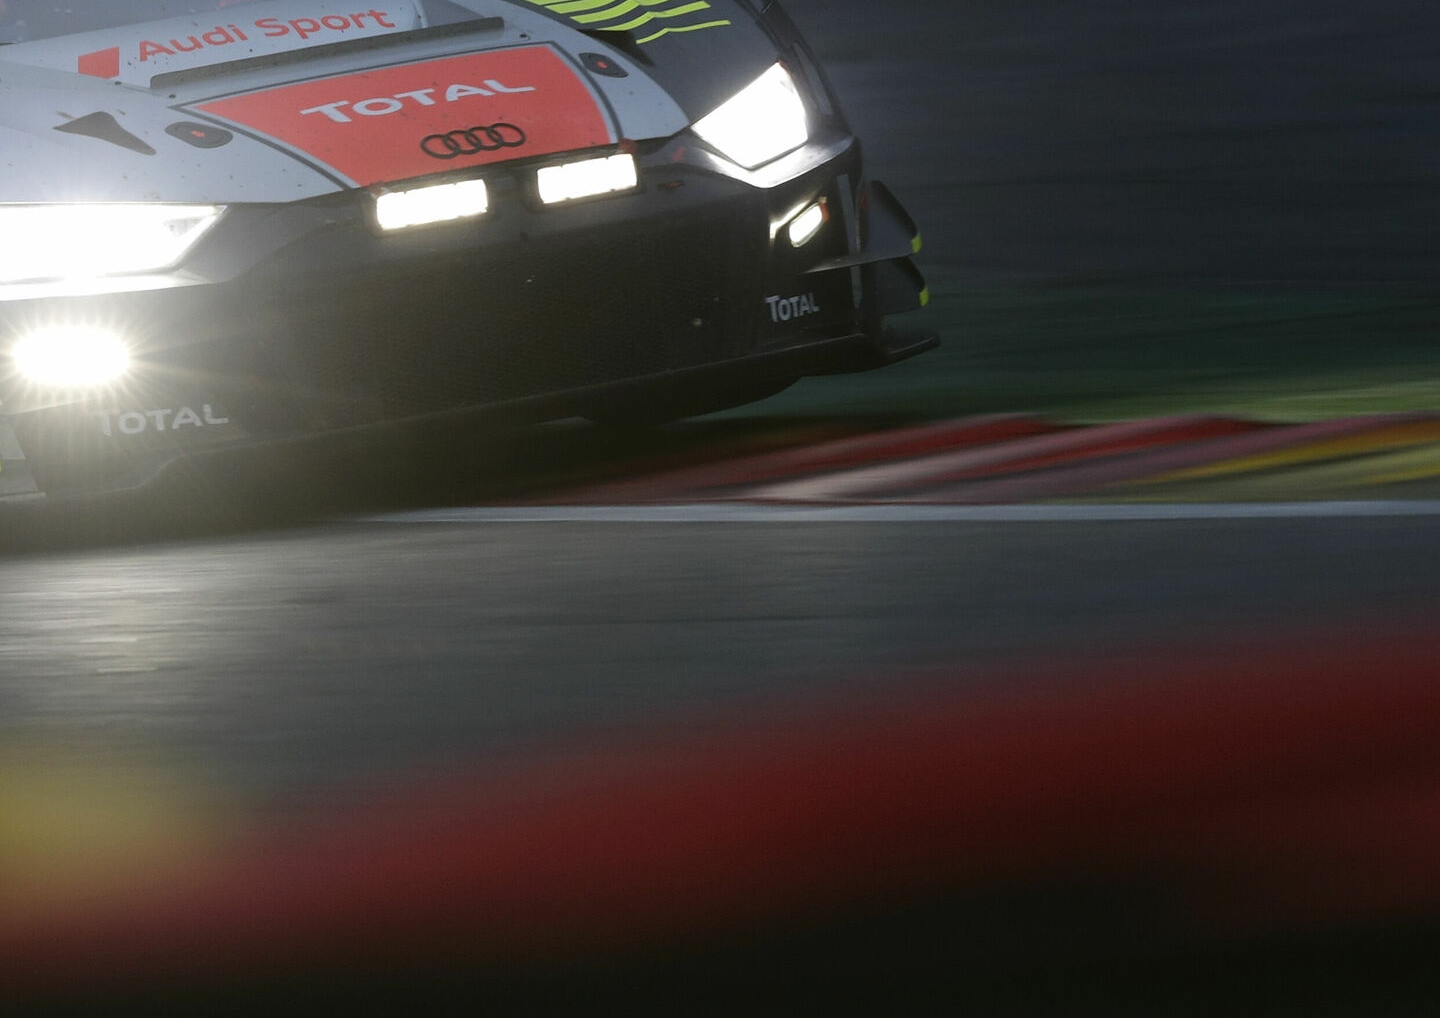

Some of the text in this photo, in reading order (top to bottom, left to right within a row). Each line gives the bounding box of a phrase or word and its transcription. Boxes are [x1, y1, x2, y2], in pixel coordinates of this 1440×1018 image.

[139, 8, 396, 62] Audi Sport
[300, 78, 537, 124] TOTAL
[764, 292, 820, 323] TOTAL
[89, 403, 230, 437] TOTAL
